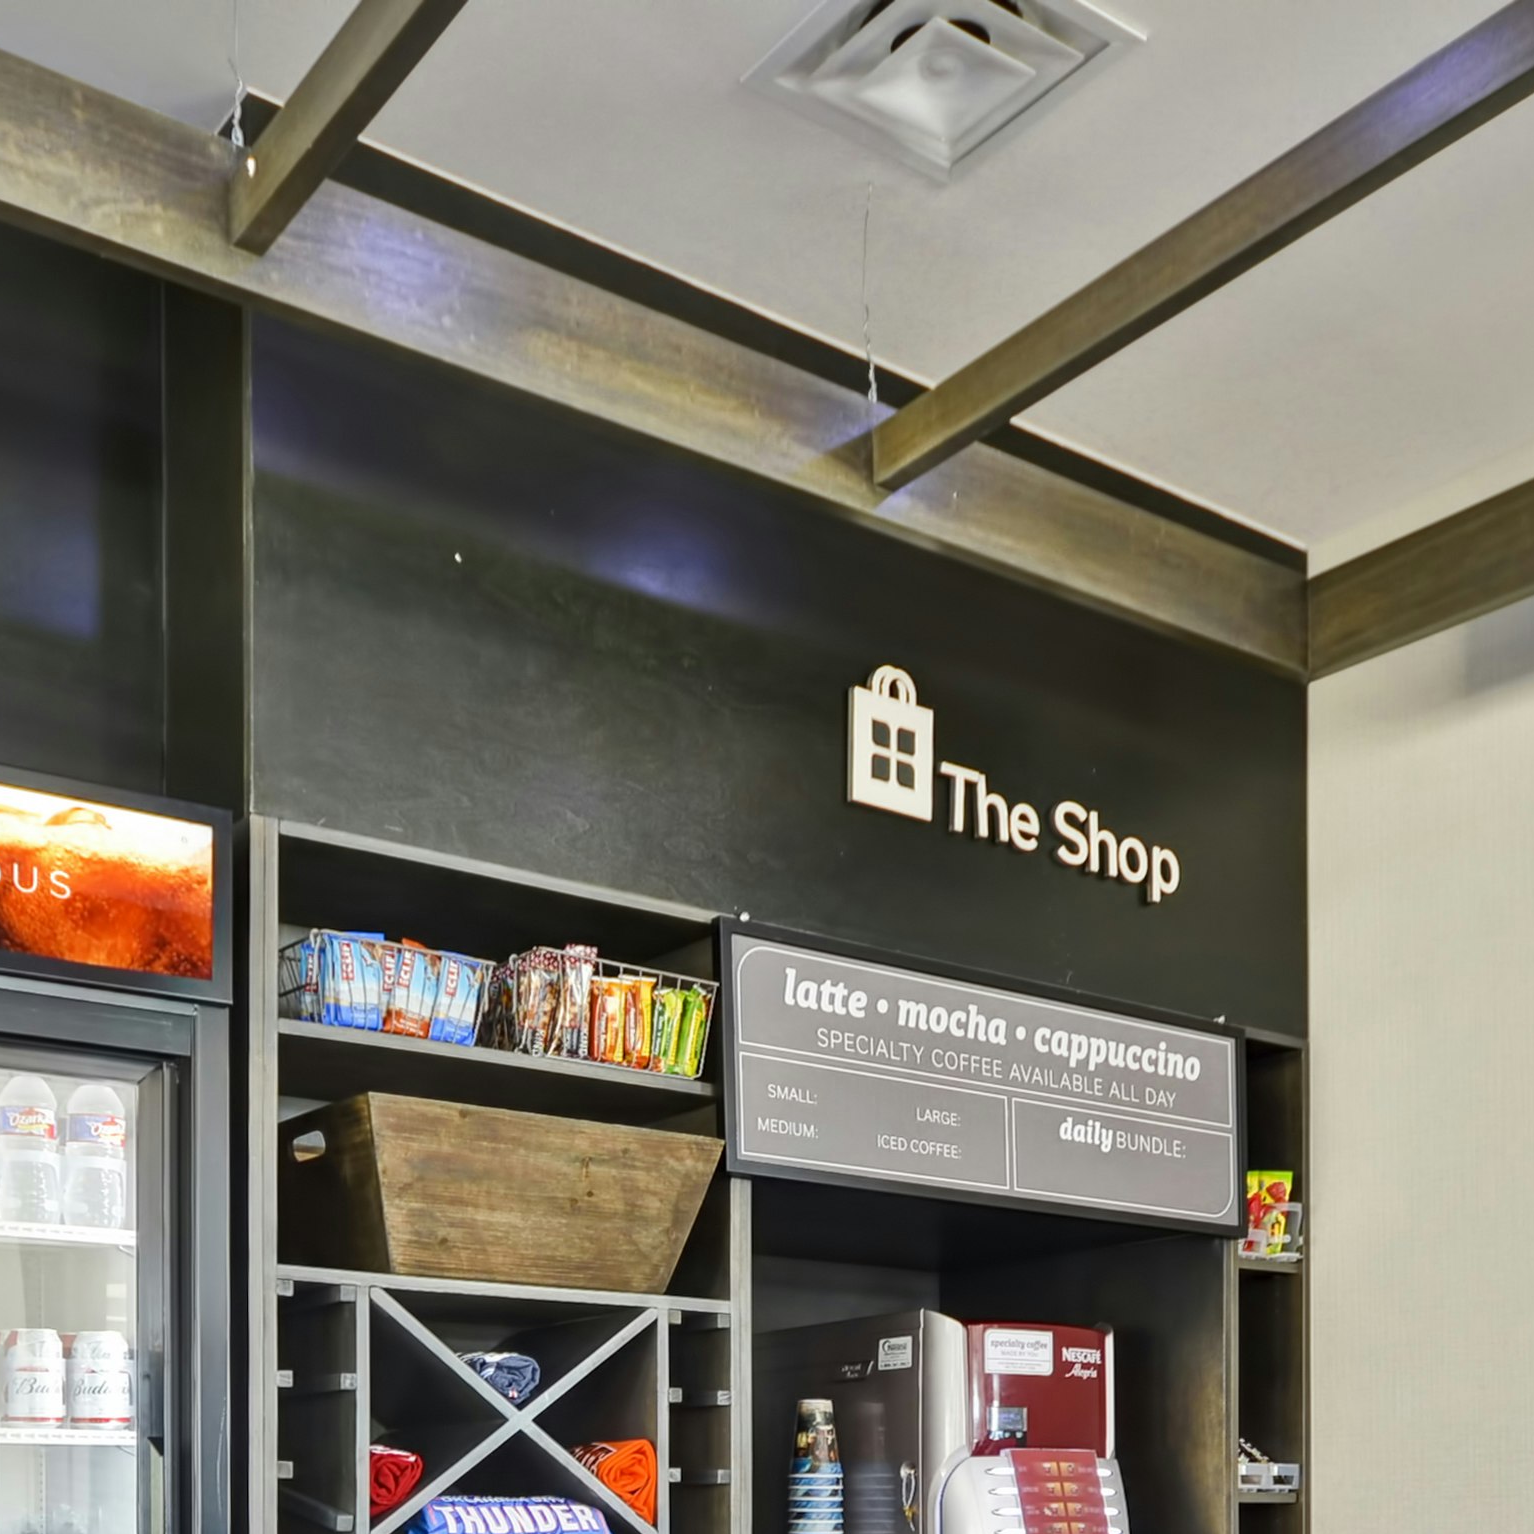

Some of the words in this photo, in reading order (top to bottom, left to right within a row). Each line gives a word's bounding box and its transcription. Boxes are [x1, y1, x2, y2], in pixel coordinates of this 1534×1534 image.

[939, 760, 1041, 852] The
[1050, 800, 1181, 903] Shop
[783, 966, 868, 1018] latte
[897, 997, 1008, 1047] mocha
[1033, 1022, 1201, 1083] cappuccino
[817, 1027, 925, 1066] SPECIALTY
[931, 1047, 1004, 1080] COFFEE
[1009, 1061, 1104, 1098] AVAILABLE
[1108, 1080, 1140, 1104] ALL
[1144, 1086, 1177, 1110] DAY
[766, 1083, 818, 1106] SMALL:
[757, 1117, 820, 1140] MEDIUM:
[915, 1106, 962, 1128] LARGE:
[876, 1133, 909, 1153] ICED
[909, 1138, 962, 1161] COFFEE:
[1058, 1116, 1114, 1153] daily
[1115, 1131, 1187, 1160] BUNDLE:
